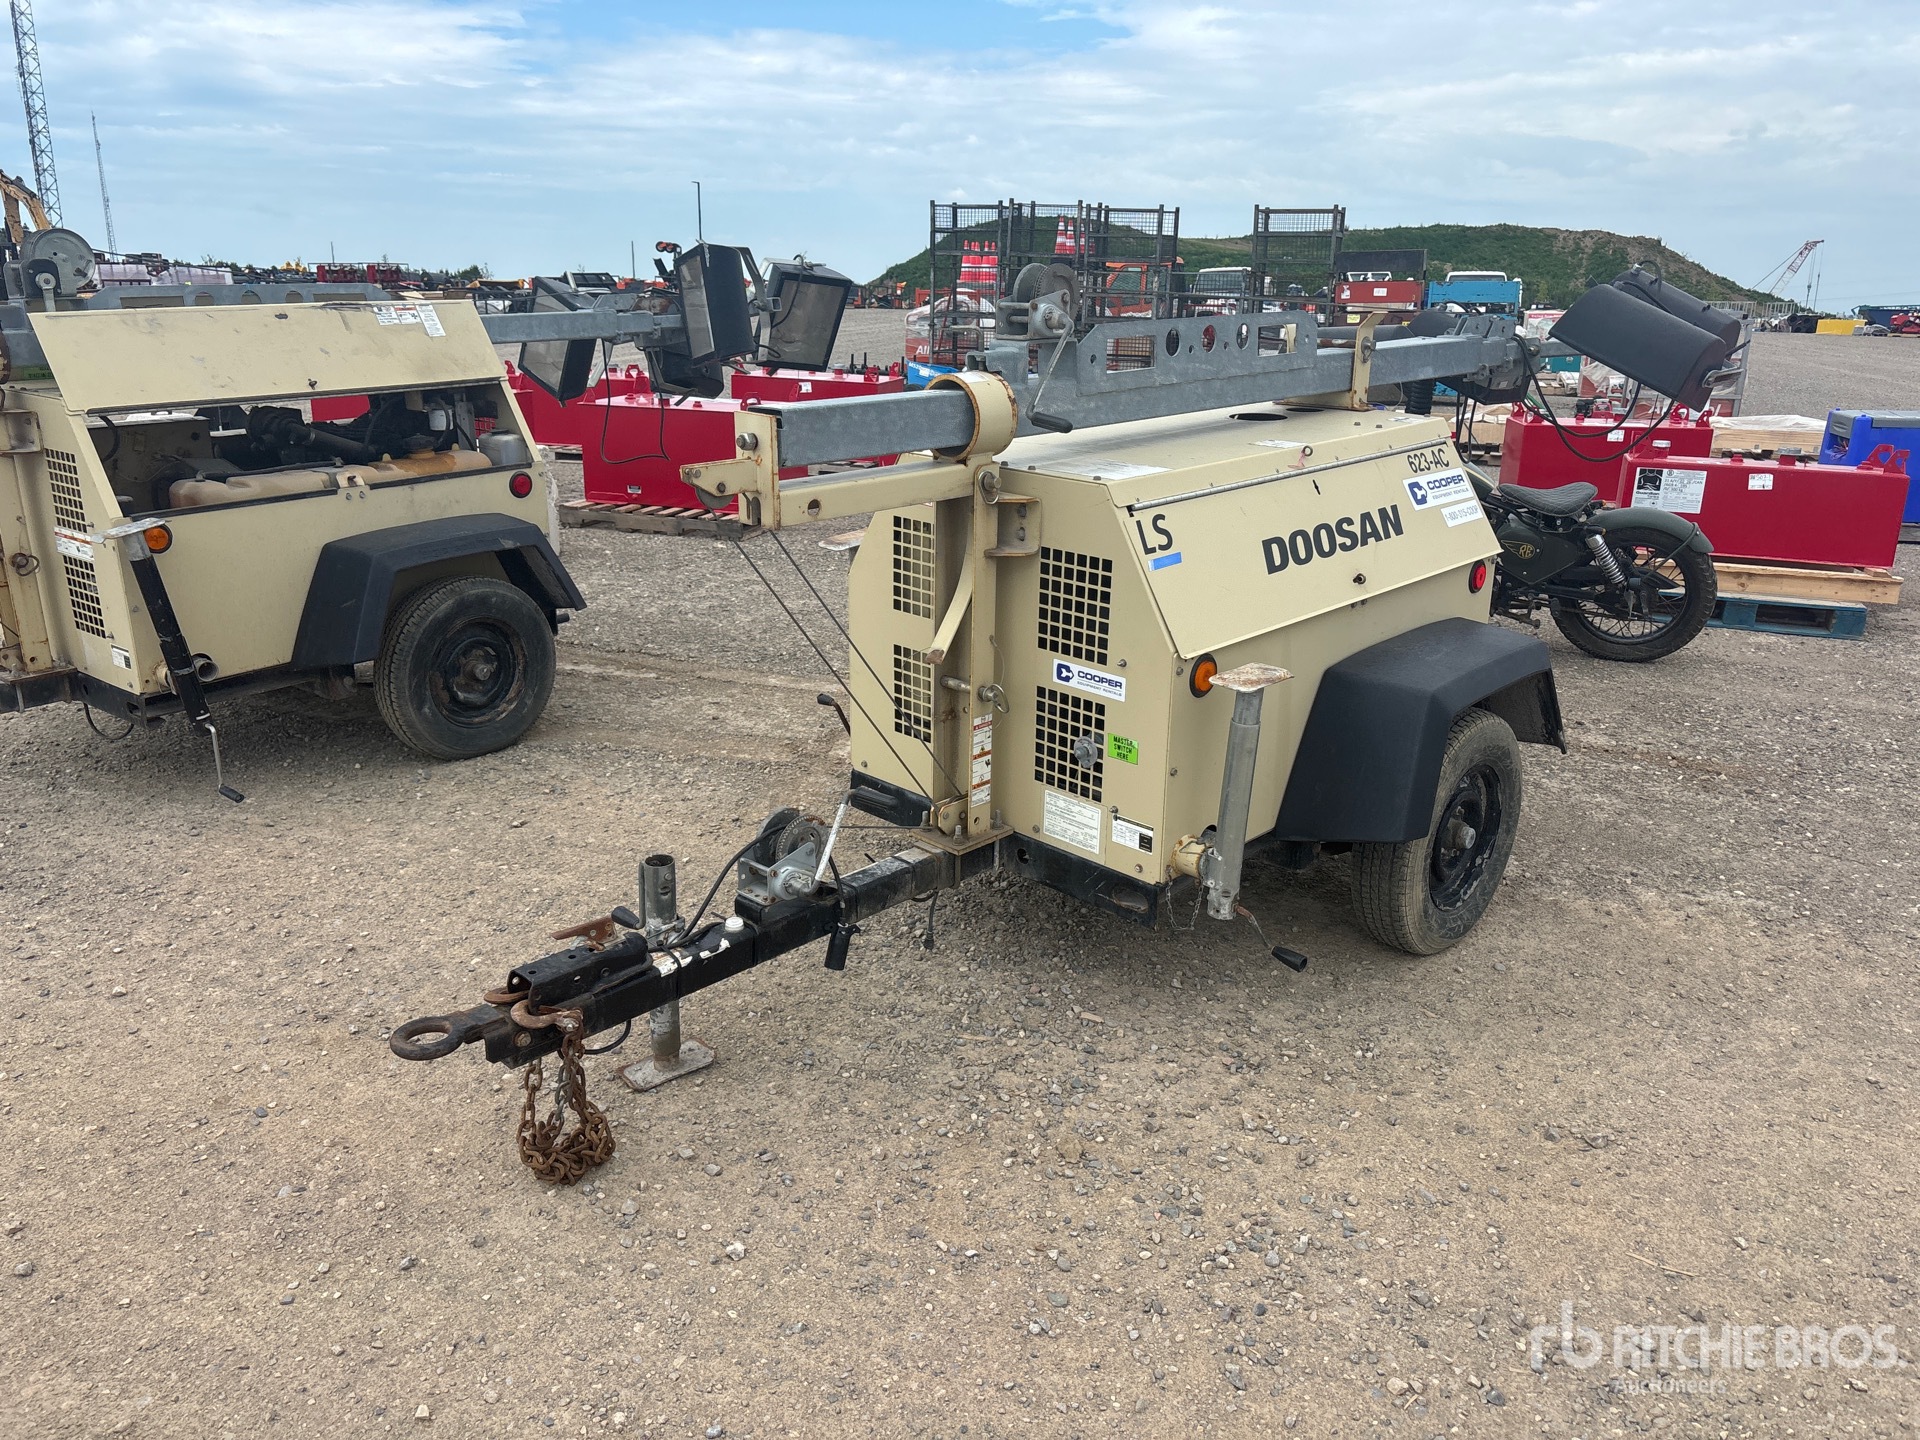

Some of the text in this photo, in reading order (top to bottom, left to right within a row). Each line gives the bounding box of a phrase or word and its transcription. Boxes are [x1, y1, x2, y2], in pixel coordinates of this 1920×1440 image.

[1407, 448, 1450, 473] 623-AC
[1427, 474, 1465, 490] COOPER
[1136, 514, 1173, 555] LS
[1262, 504, 1404, 575] DOOSAN
[1077, 670, 1123, 690] COOPER
[1077, 681, 1122, 697] EQUIPMENT RENTALS
[1113, 735, 1134, 747] MASTER
[1113, 743, 1133, 754] SWITCH
[1116, 751, 1129, 761] HERE
